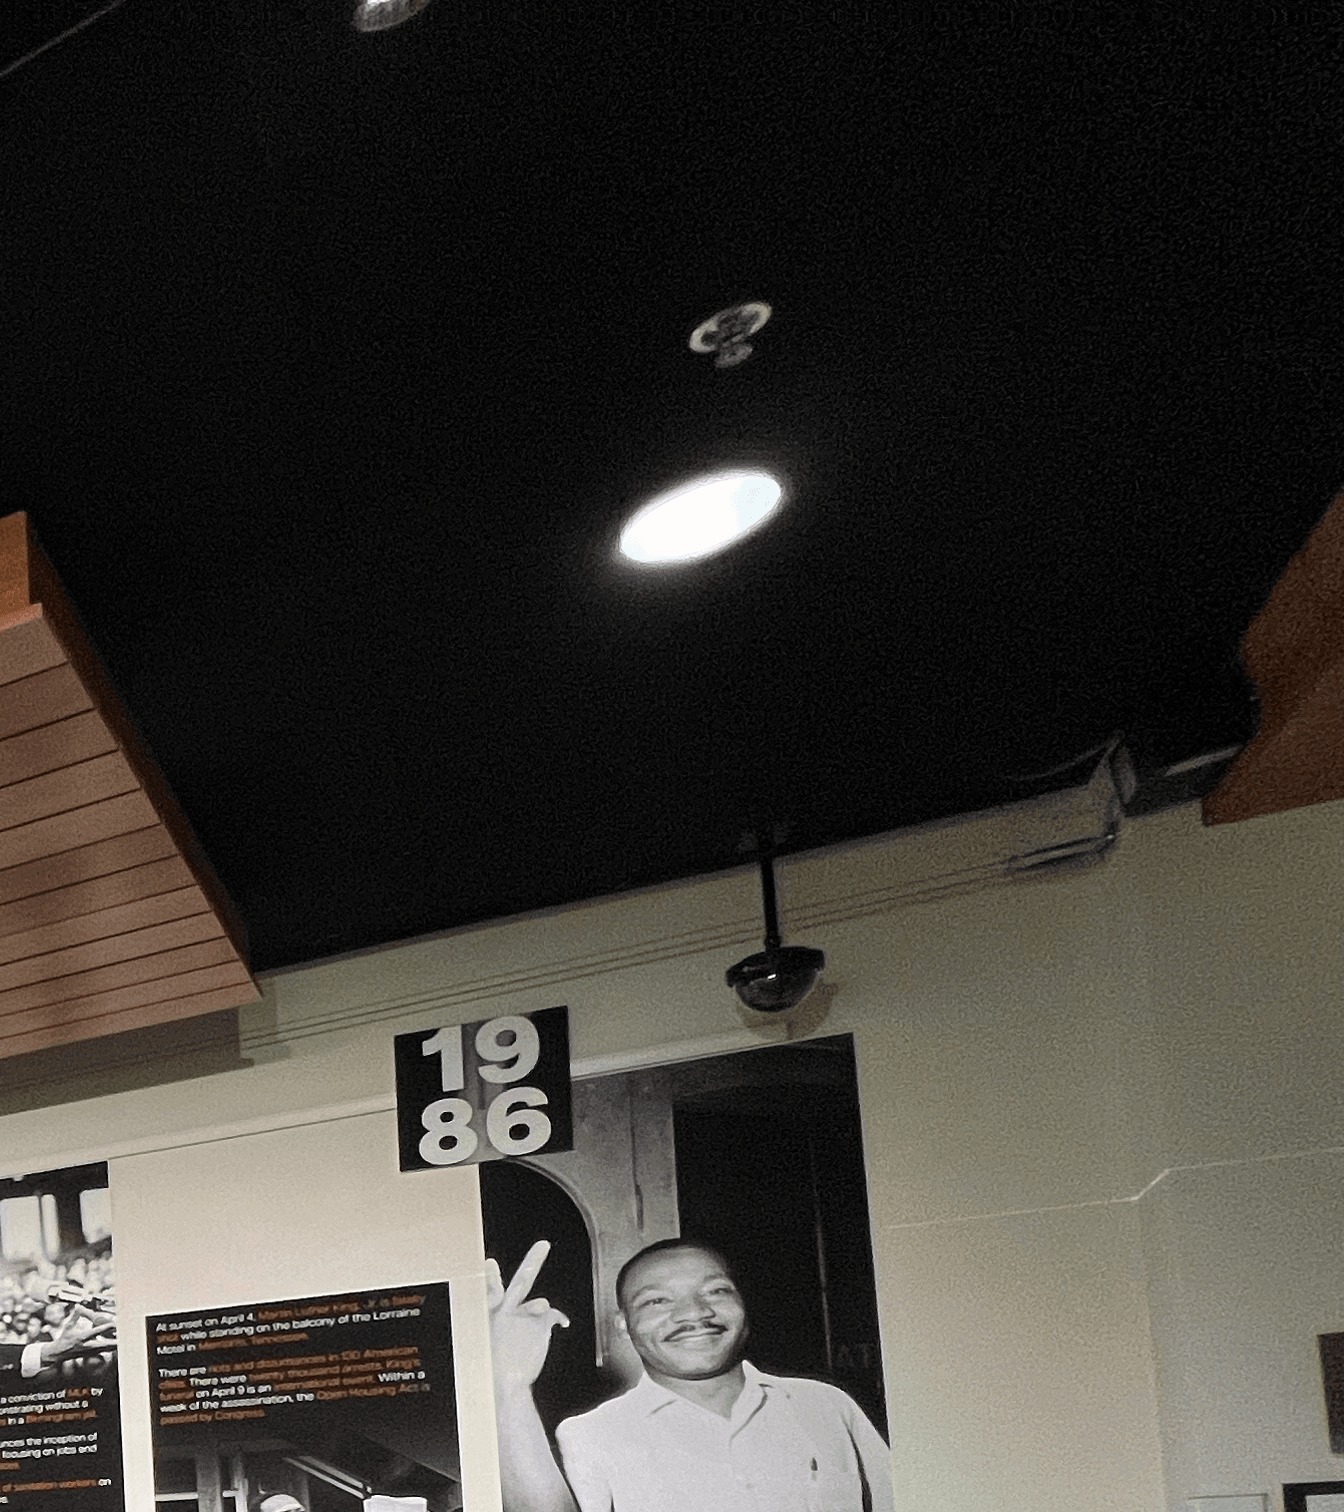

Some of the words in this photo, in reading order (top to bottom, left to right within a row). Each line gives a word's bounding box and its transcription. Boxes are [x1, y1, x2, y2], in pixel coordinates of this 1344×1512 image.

[422, 1014, 540, 1091] 19
[419, 1086, 551, 1165] 86
[181, 1329, 206, 1341] while
[272, 1321, 290, 1331] the
[292, 1316, 334, 1329] balcony
[352, 1313, 370, 1323] the
[221, 1314, 245, 1327] April
